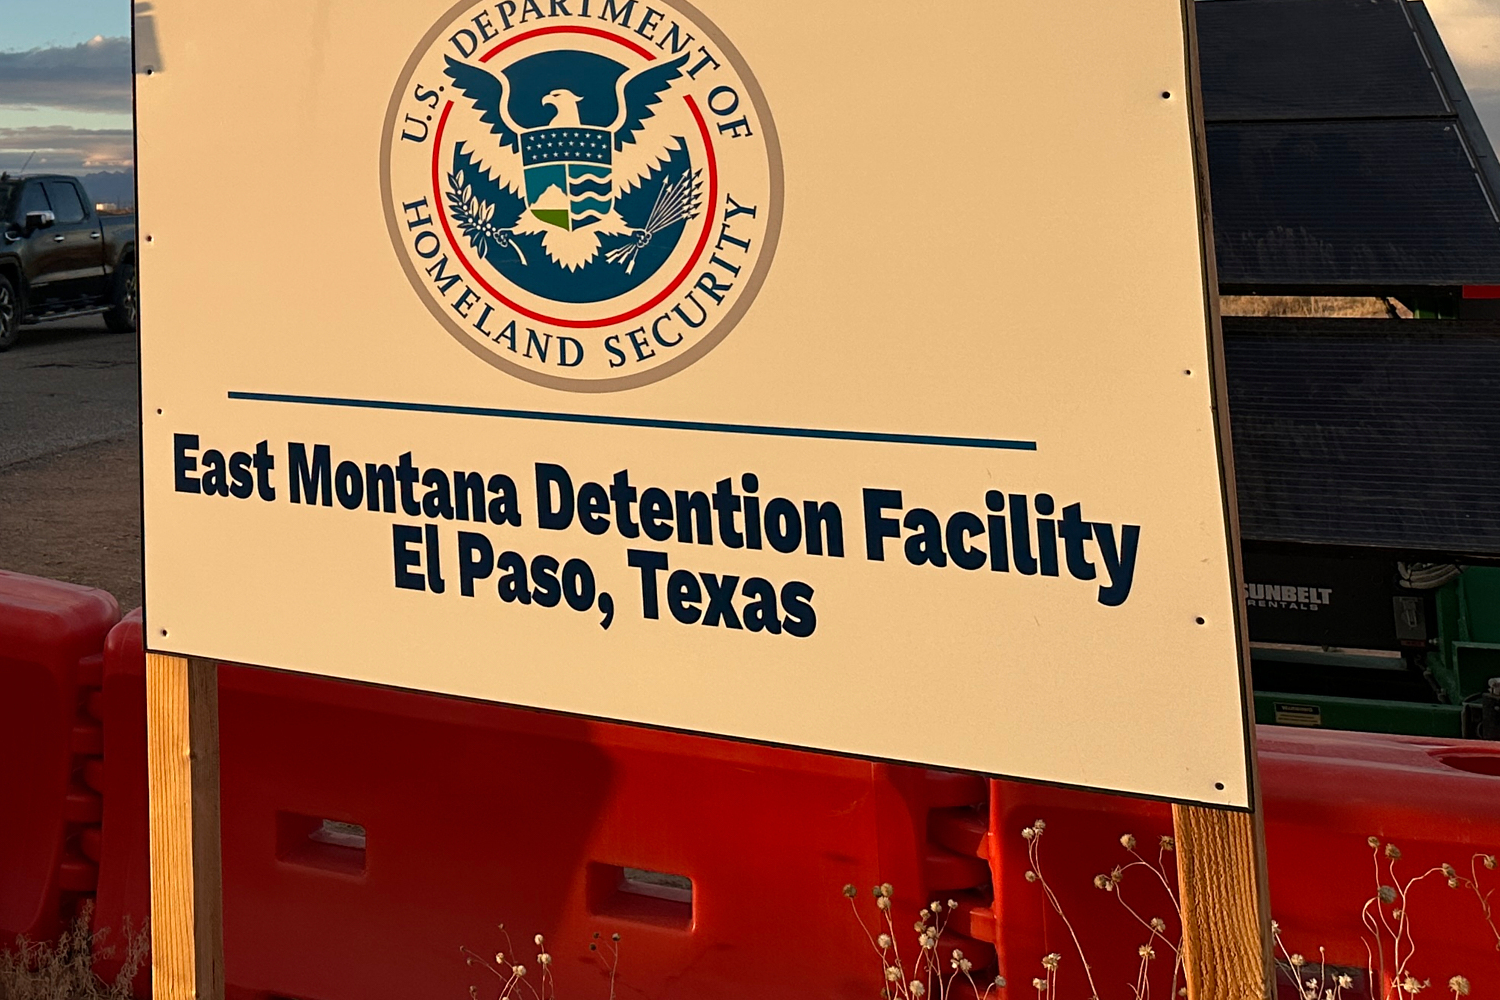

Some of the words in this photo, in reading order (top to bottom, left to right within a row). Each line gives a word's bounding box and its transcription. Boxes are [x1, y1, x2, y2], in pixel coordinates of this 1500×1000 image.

[401, 84, 445, 143] U.S.
[707, 85, 753, 139] OF
[402, 195, 584, 368] HOMELAND
[604, 192, 757, 368] SECURITY
[173, 433, 276, 502] East
[287, 441, 522, 527] Montana
[534, 462, 845, 558] Detention
[862, 487, 1141, 607] Facility
[392, 523, 445, 594] El
[457, 530, 615, 630] Paso,
[627, 549, 817, 638] Texas
[1247, 600, 1318, 611] RENTALS
